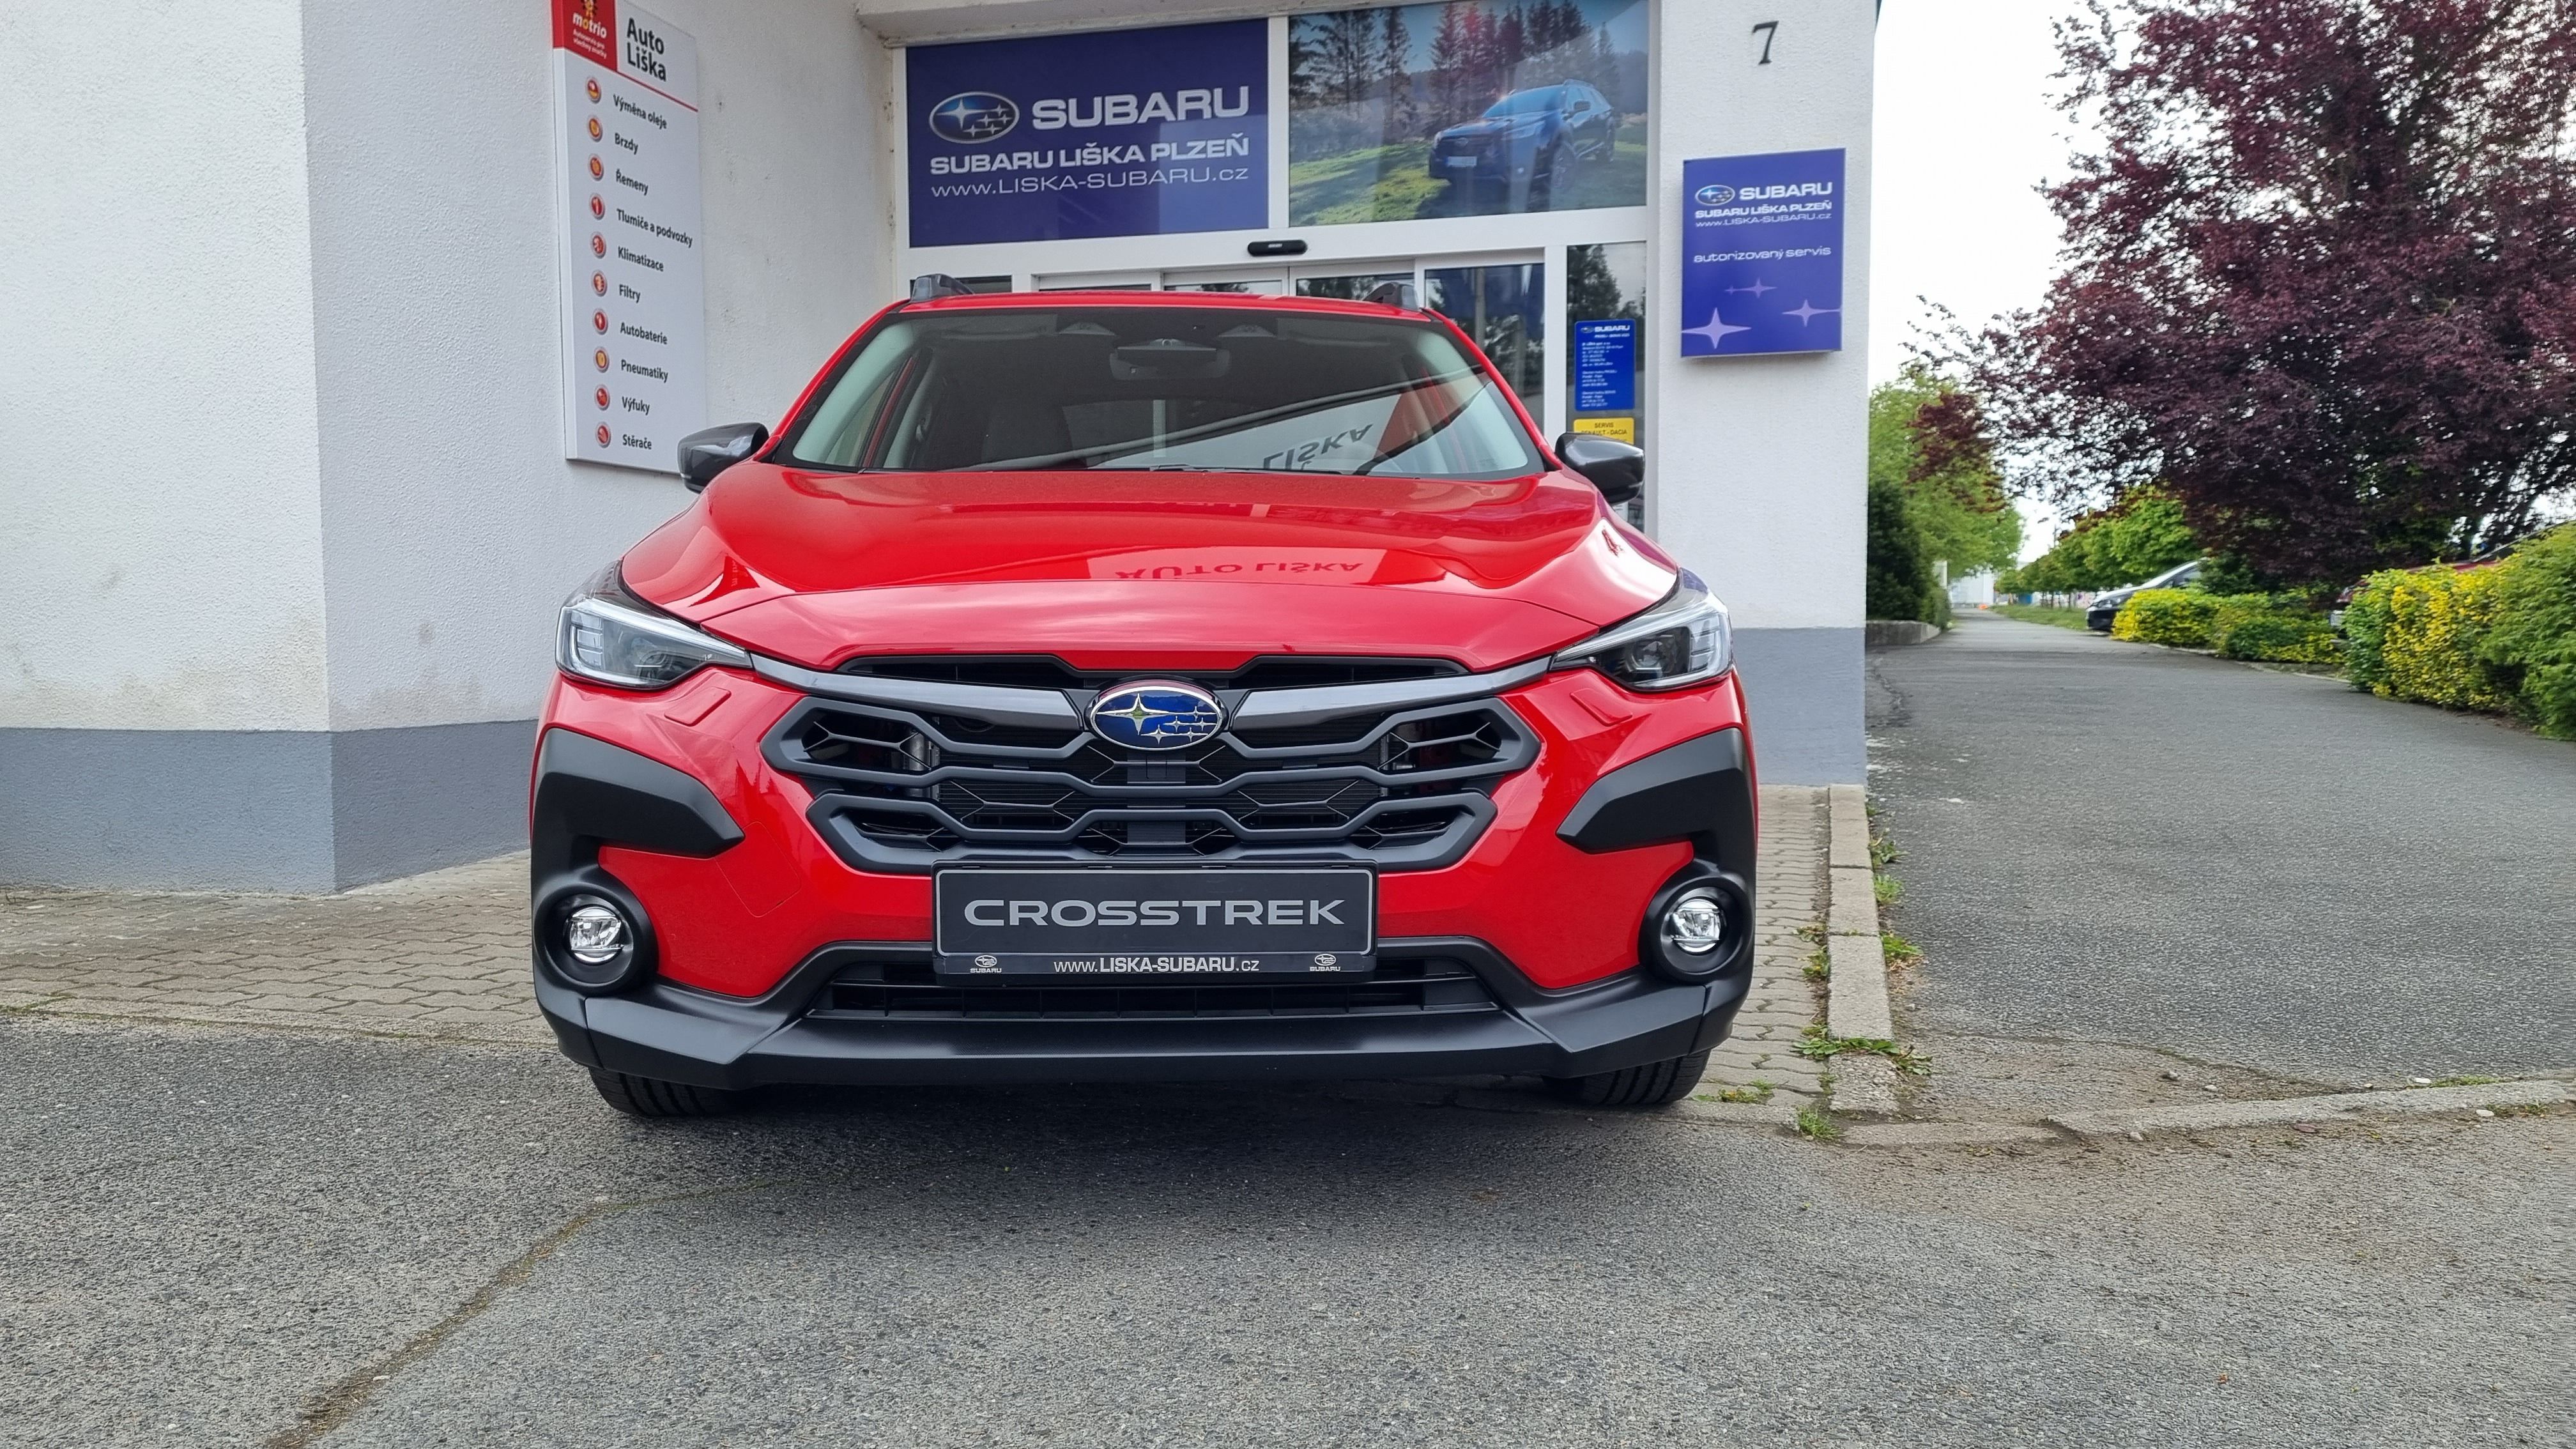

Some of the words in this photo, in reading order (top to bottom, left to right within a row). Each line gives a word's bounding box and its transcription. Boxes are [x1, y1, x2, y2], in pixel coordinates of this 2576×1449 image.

[572, 12, 608, 39] motrio
[626, 18, 664, 56] Auto
[1751, 20, 1779, 65] 7
[627, 43, 667, 82] Liška
[613, 94, 647, 120] Výměna
[648, 112, 668, 129] oleje
[1032, 86, 1249, 130] SUBARU
[615, 133, 638, 155] Brzdy
[930, 150, 1054, 175] SUBARU
[1059, 142, 1145, 167] LIŠKA
[1151, 133, 1249, 161] PLZEŇ
[615, 169, 648, 195] Řemeny
[931, 167, 1248, 197] www.LISKA-SUBARU.cz
[1739, 181, 1833, 201] SUBARU
[1695, 207, 1749, 218] SUBARU
[1751, 204, 1788, 215] LIŠKA
[1790, 200, 1832, 212] PLZEŇ
[1695, 213, 1832, 227] www.LISKA-SUBARU.cz
[617, 208, 649, 231] Tlumiče
[650, 223, 655, 233] a
[656, 227, 693, 249] podvozky
[618, 246, 664, 272] Klimatizace
[1694, 249, 1784, 263] autorizovaný
[1786, 245, 1832, 257] servis
[619, 284, 641, 303] Filtry
[620, 322, 668, 345] Autobaterie
[621, 359, 668, 383] Pneumatiky
[622, 396, 650, 416] Výfuky
[622, 434, 652, 450] Stěrače
[964, 900, 1346, 926] CROSSTREK
[1054, 957, 1260, 972] www.LISKA-SUBARU.cz
